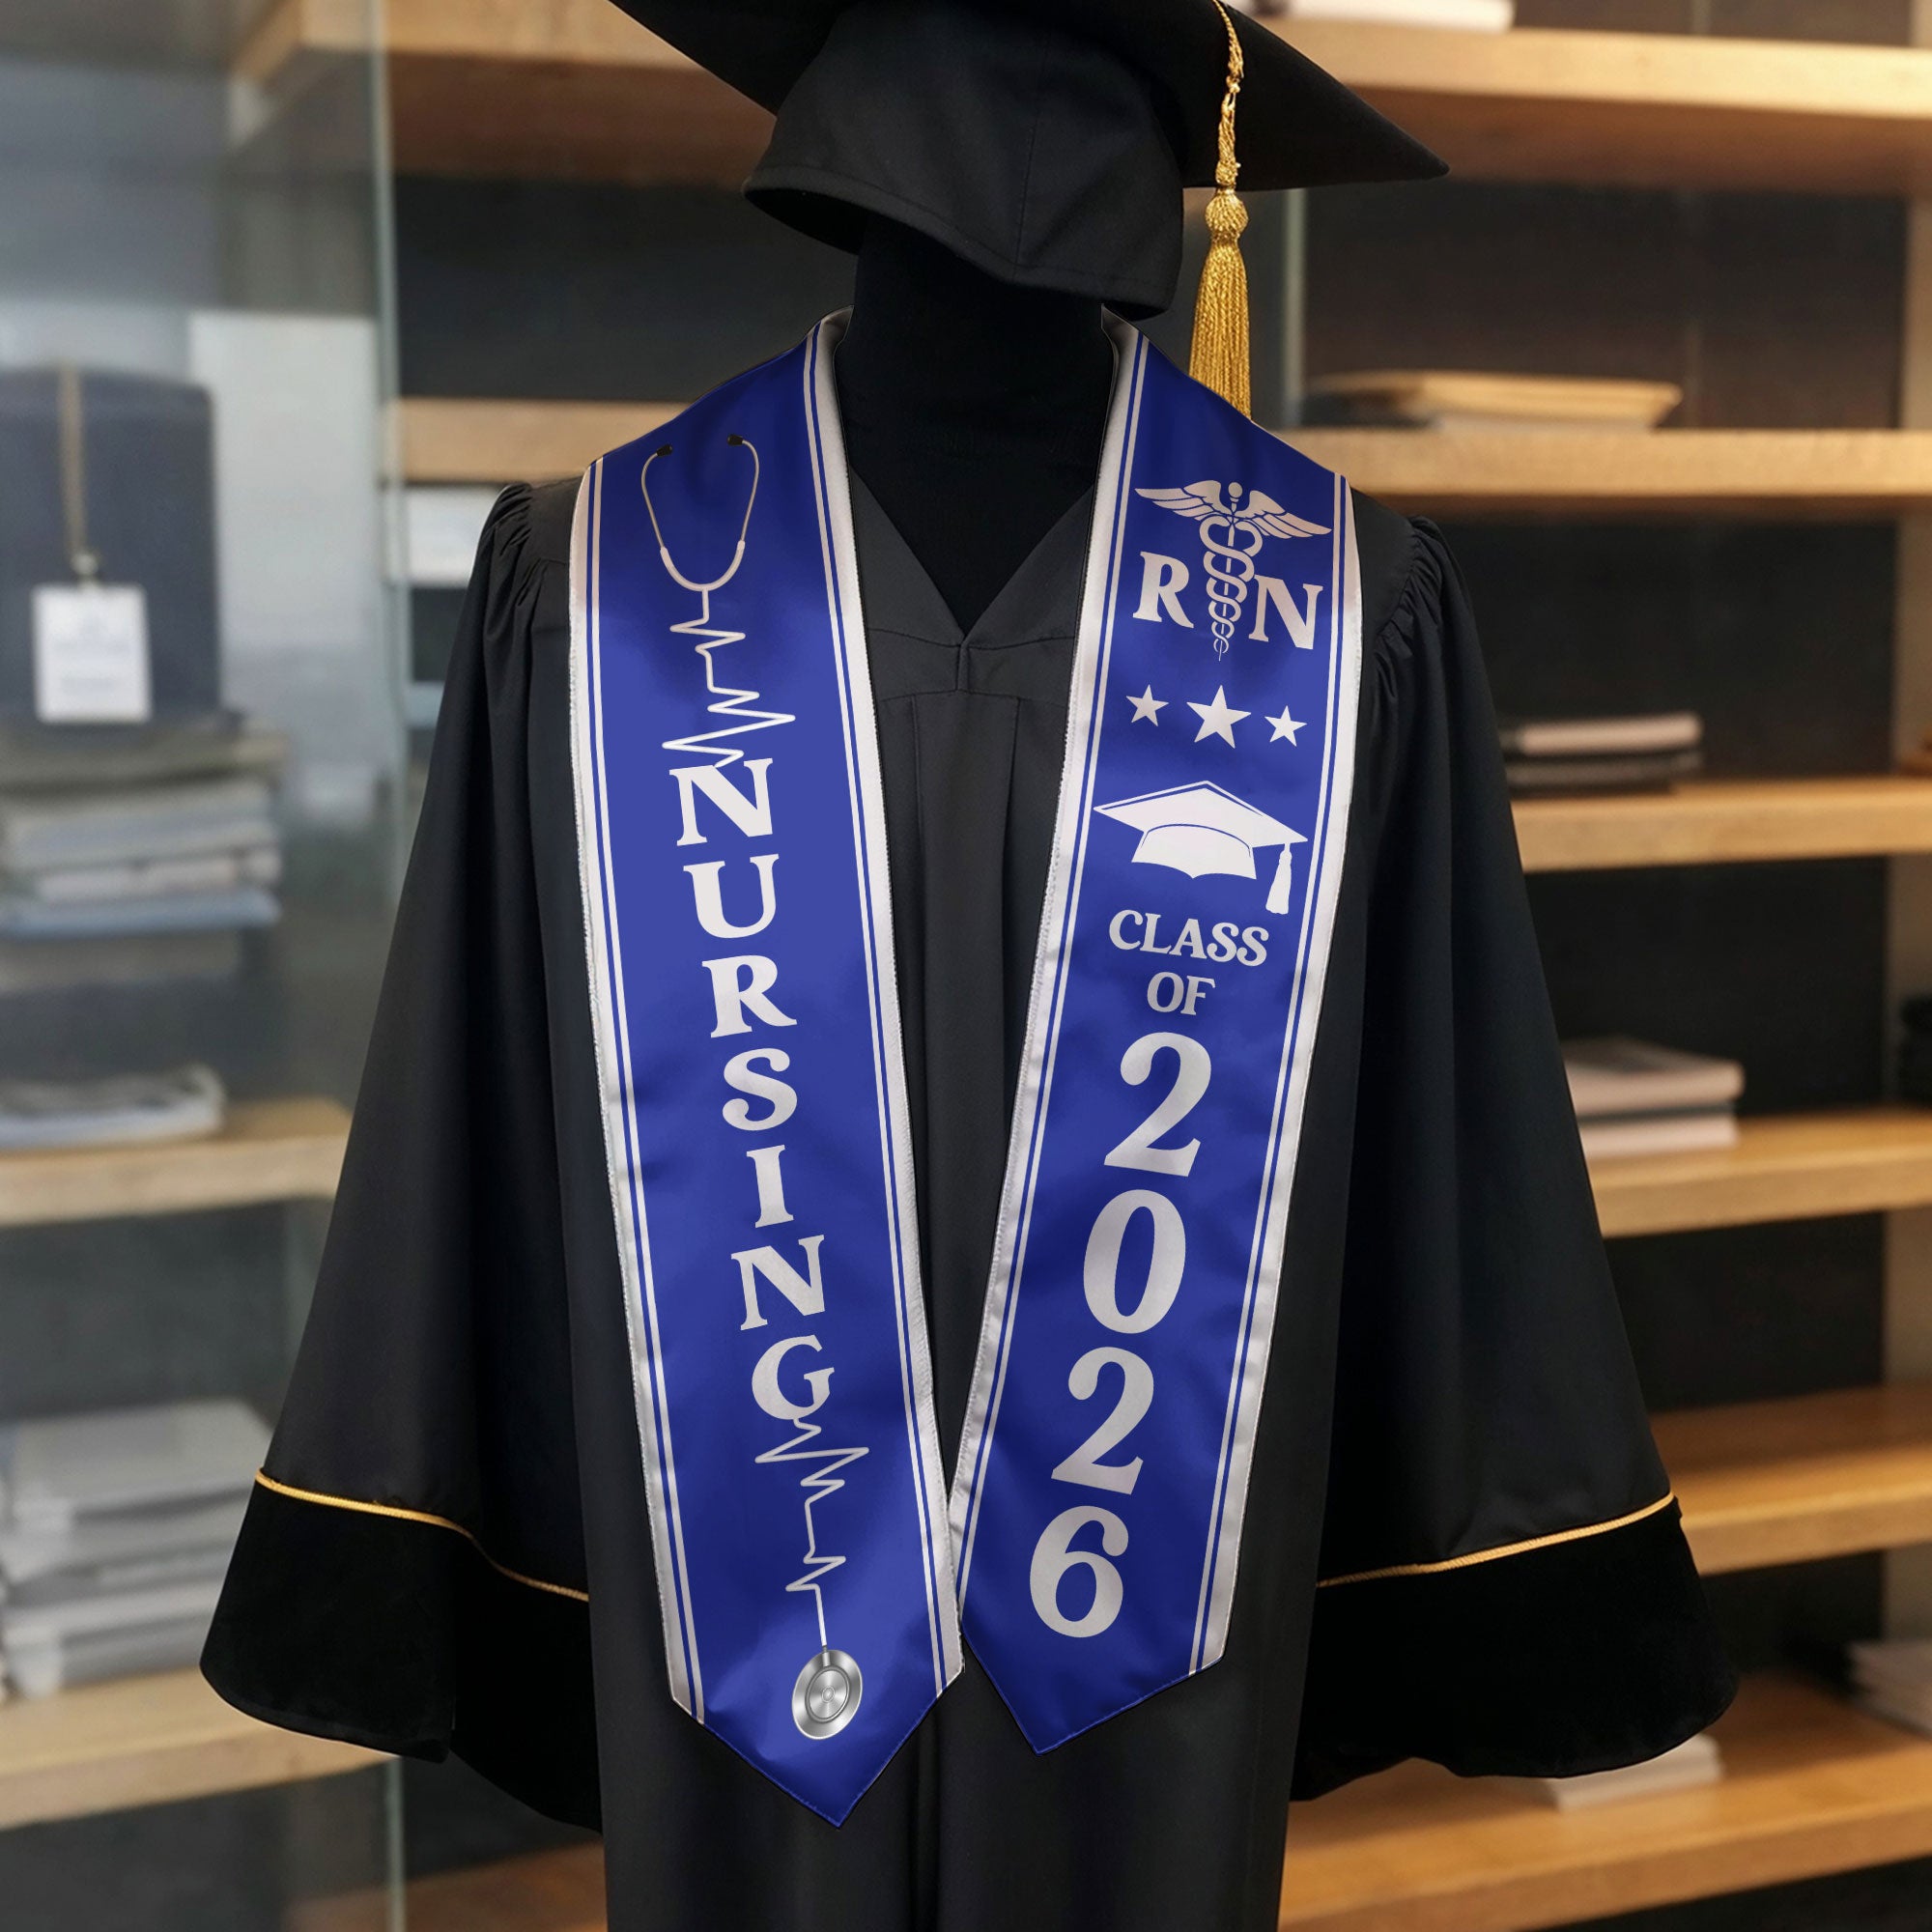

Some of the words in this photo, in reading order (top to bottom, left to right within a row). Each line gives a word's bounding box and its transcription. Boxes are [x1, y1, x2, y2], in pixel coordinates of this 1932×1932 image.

[668, 757, 836, 1420] NURSING
[1109, 909, 1269, 967] CLASS
[1147, 971, 1216, 1016] OF
[1029, 1032, 1213, 1638] 2026
